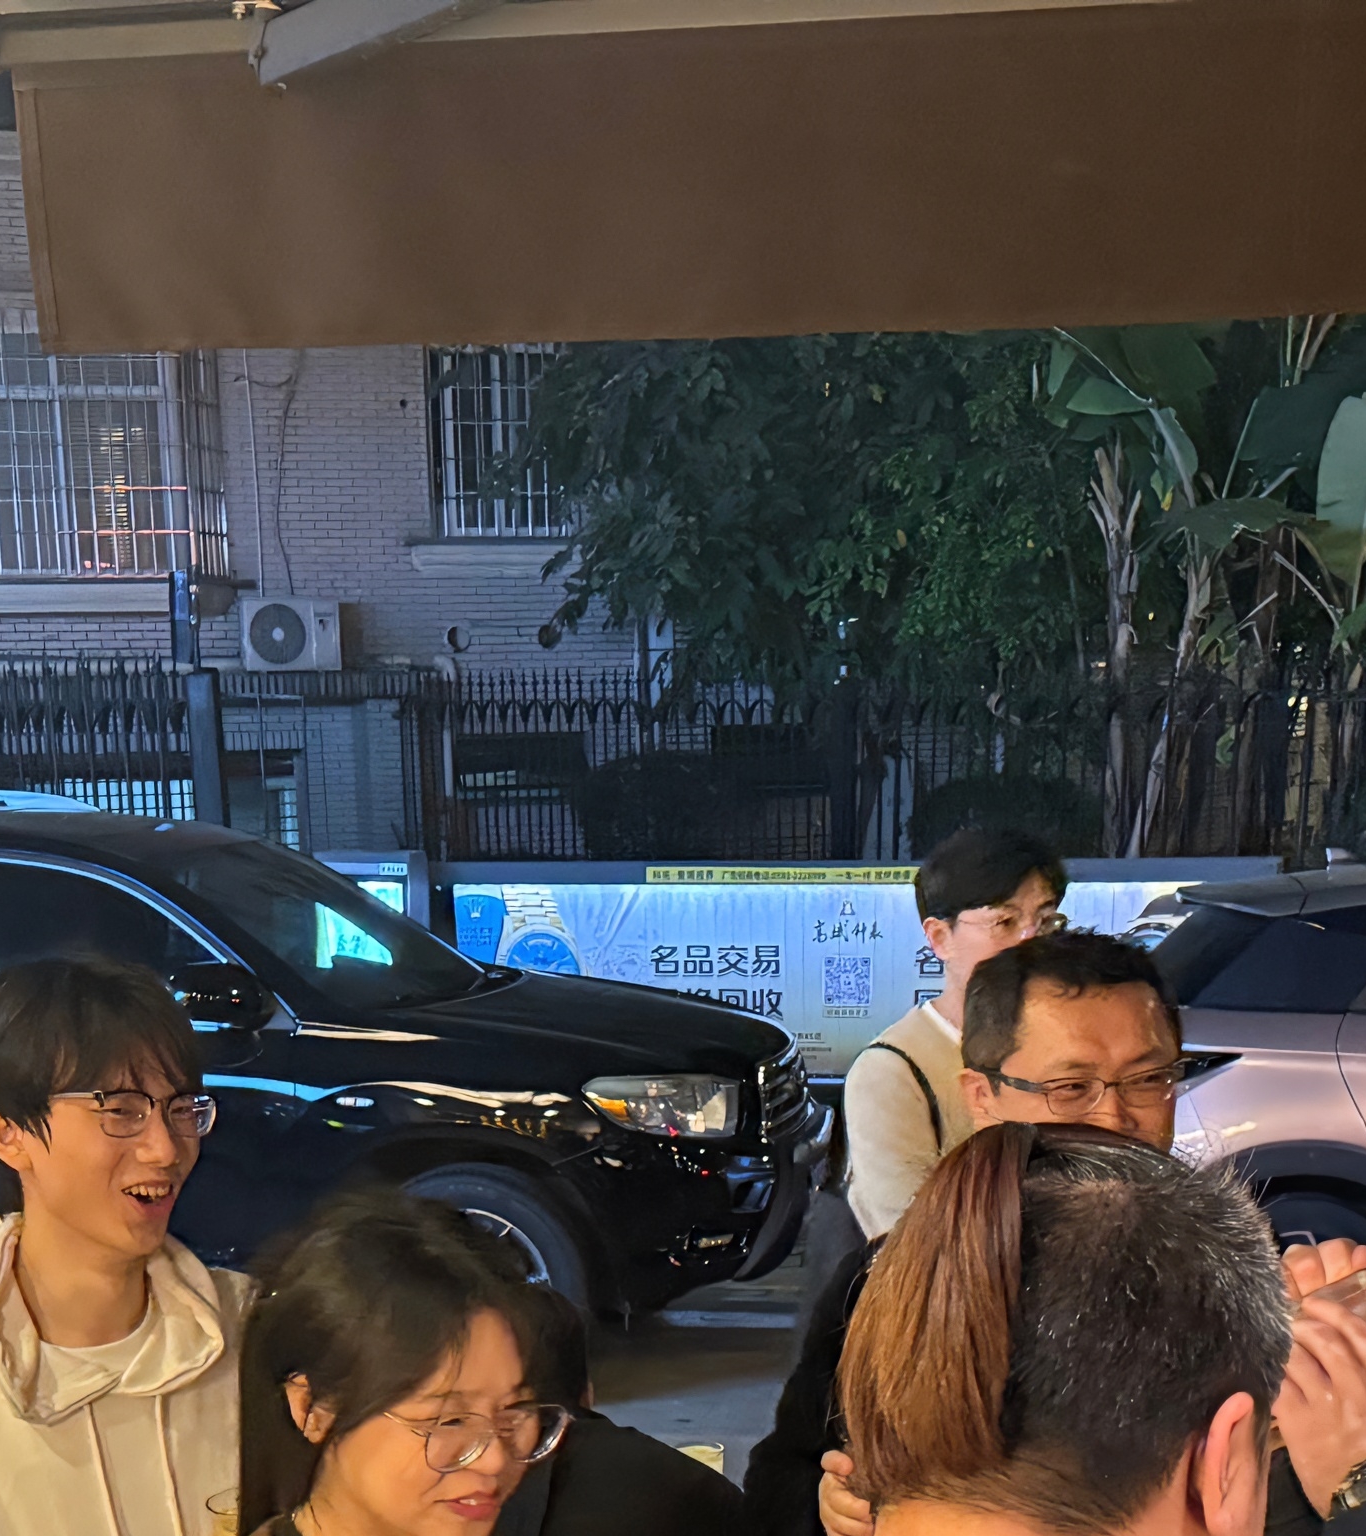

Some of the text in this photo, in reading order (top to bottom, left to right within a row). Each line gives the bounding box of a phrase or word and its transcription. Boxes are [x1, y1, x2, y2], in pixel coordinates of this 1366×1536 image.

[650, 944, 781, 975] 名品交易
[688, 988, 783, 1017] 回收
